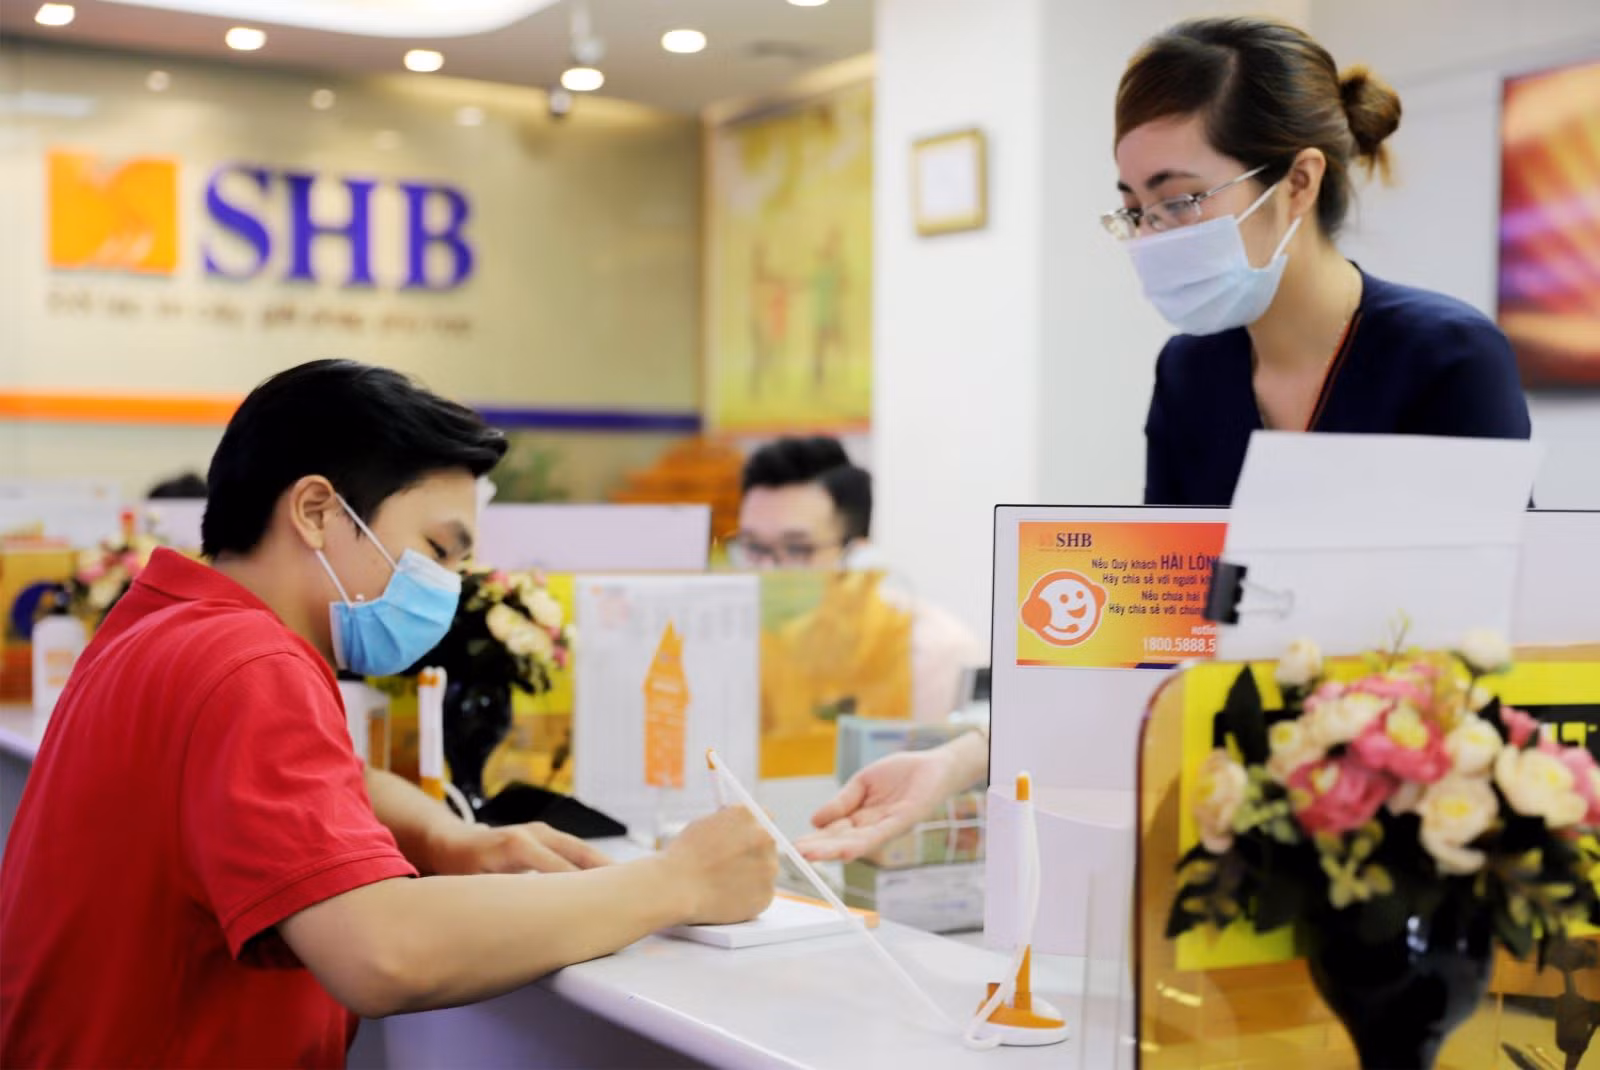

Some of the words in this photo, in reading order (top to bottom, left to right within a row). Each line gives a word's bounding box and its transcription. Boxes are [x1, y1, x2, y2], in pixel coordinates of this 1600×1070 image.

[203, 160, 475, 292] SHB
[1056, 532, 1092, 548] SHB
[1144, 637, 1217, 653] 1800.5888.5
